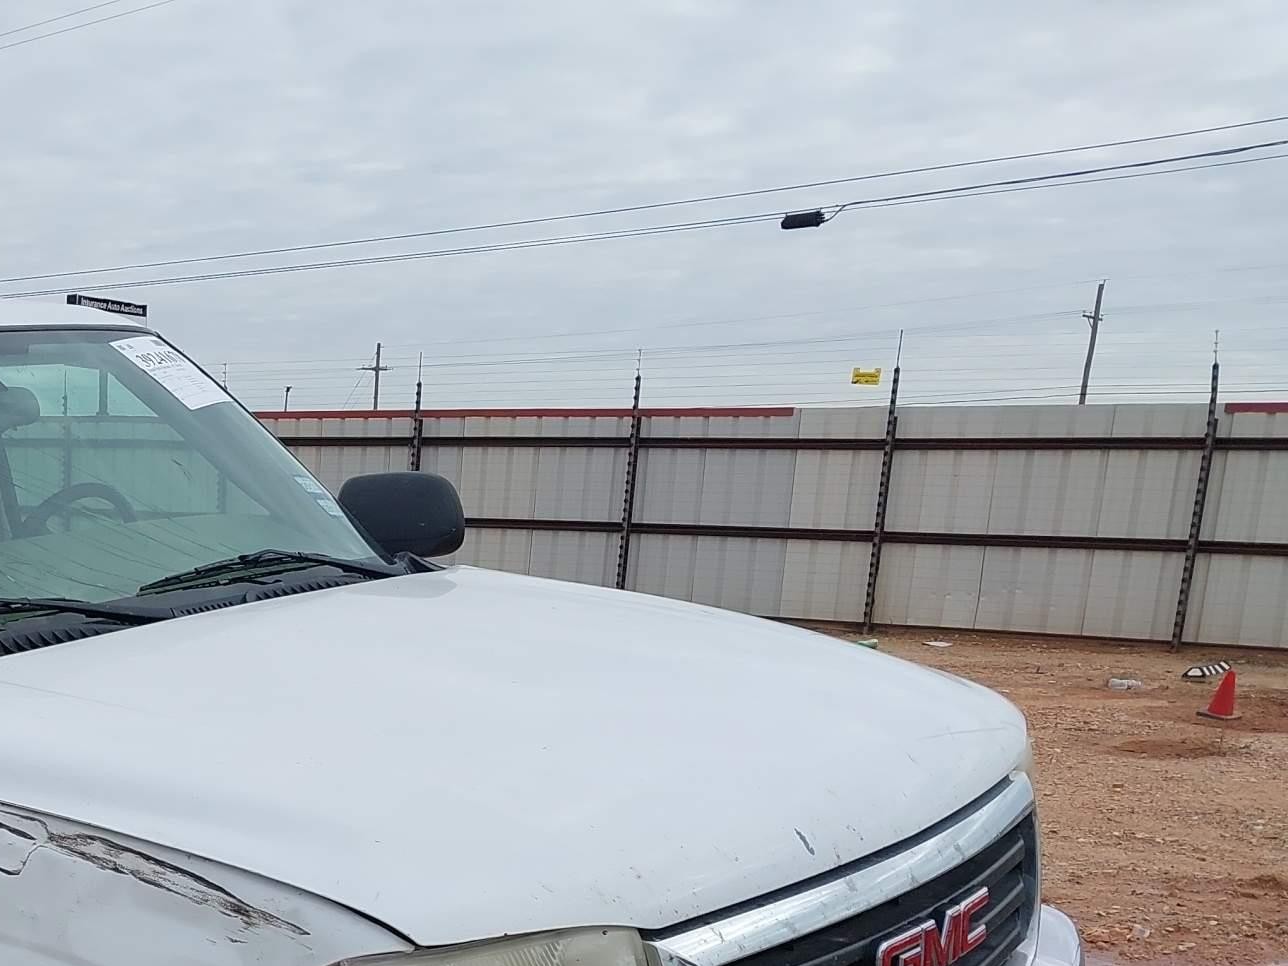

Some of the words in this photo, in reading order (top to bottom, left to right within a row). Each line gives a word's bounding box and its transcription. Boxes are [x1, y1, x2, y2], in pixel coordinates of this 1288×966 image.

[81, 297, 108, 310] Insurance
[107, 301, 120, 311] Auto
[120, 304, 143, 314] Auctions
